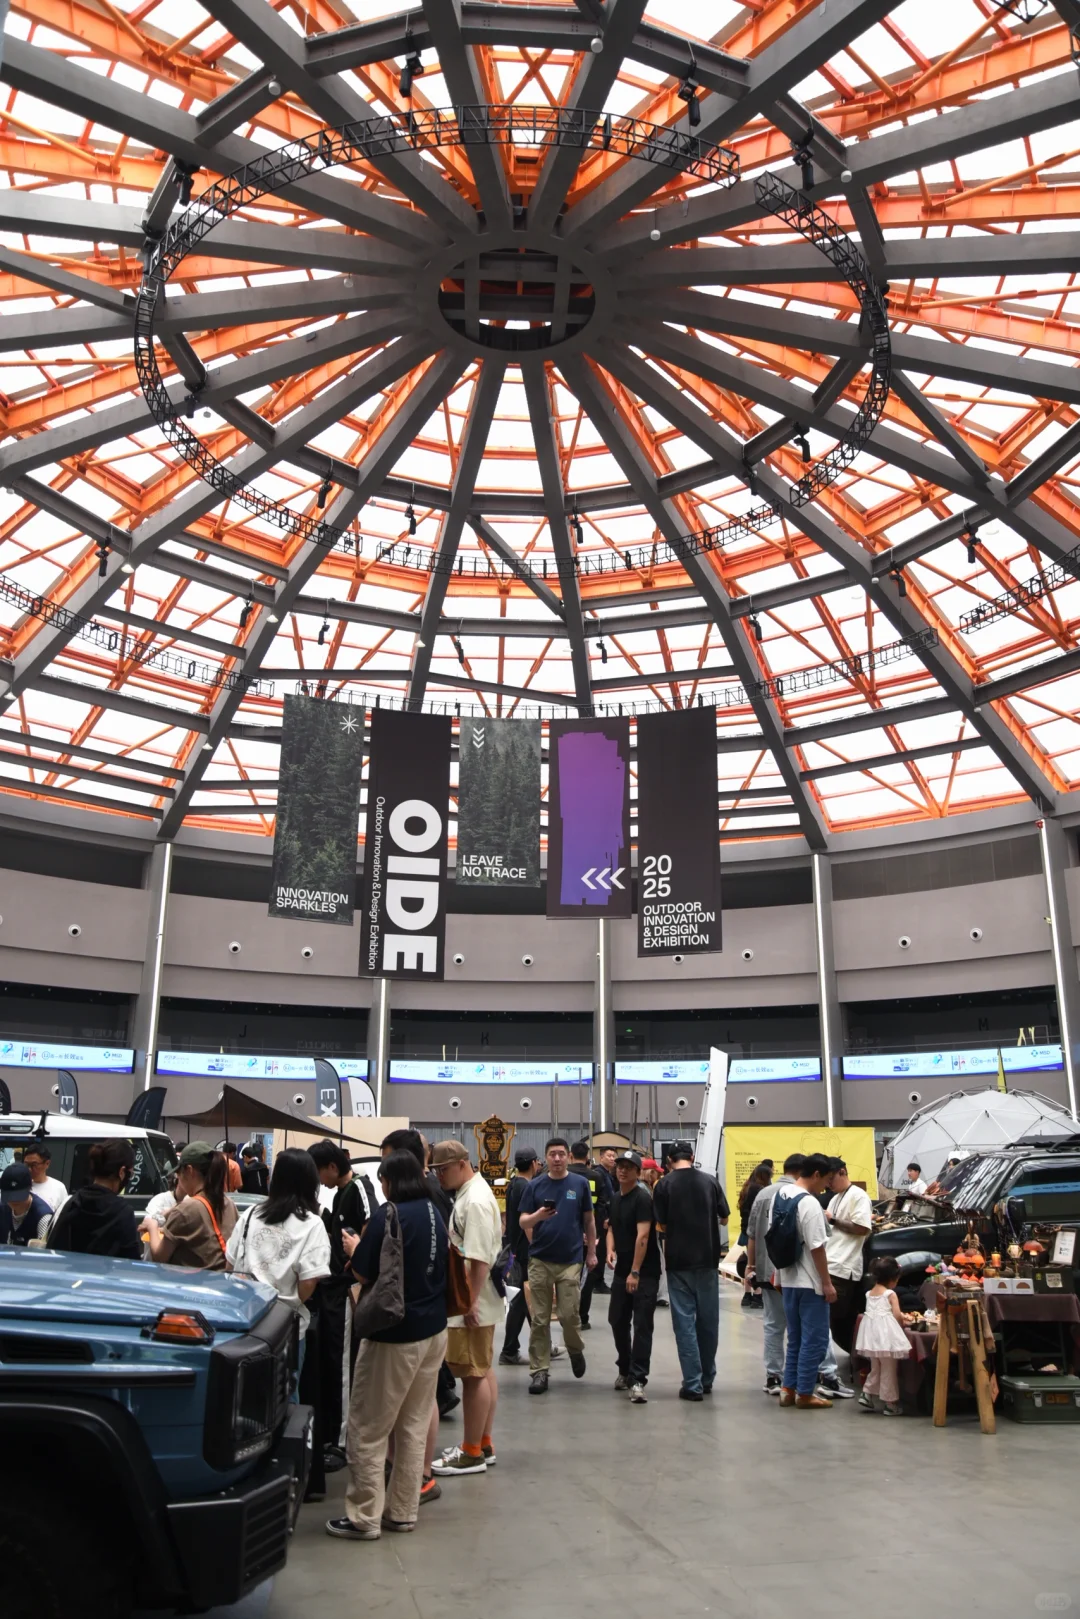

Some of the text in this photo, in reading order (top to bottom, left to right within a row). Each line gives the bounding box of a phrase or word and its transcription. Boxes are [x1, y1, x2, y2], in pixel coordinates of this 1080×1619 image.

[462, 854, 503, 866] LEAVE
[643, 855, 673, 876] 20
[462, 866, 527, 879] NO TRACE
[368, 796, 386, 970] Outdoor Innovation & Design Exhibition
[382, 799, 443, 973] OIDE
[643, 877, 672, 899] 25
[276, 886, 349, 905] INNOVATION
[275, 897, 337, 914] SPARKLES
[643, 902, 702, 915] OUTDOOR
[643, 911, 716, 926] INNOVATION
[643, 923, 698, 937] & DESIGN
[643, 934, 710, 949] EXHIBITION
